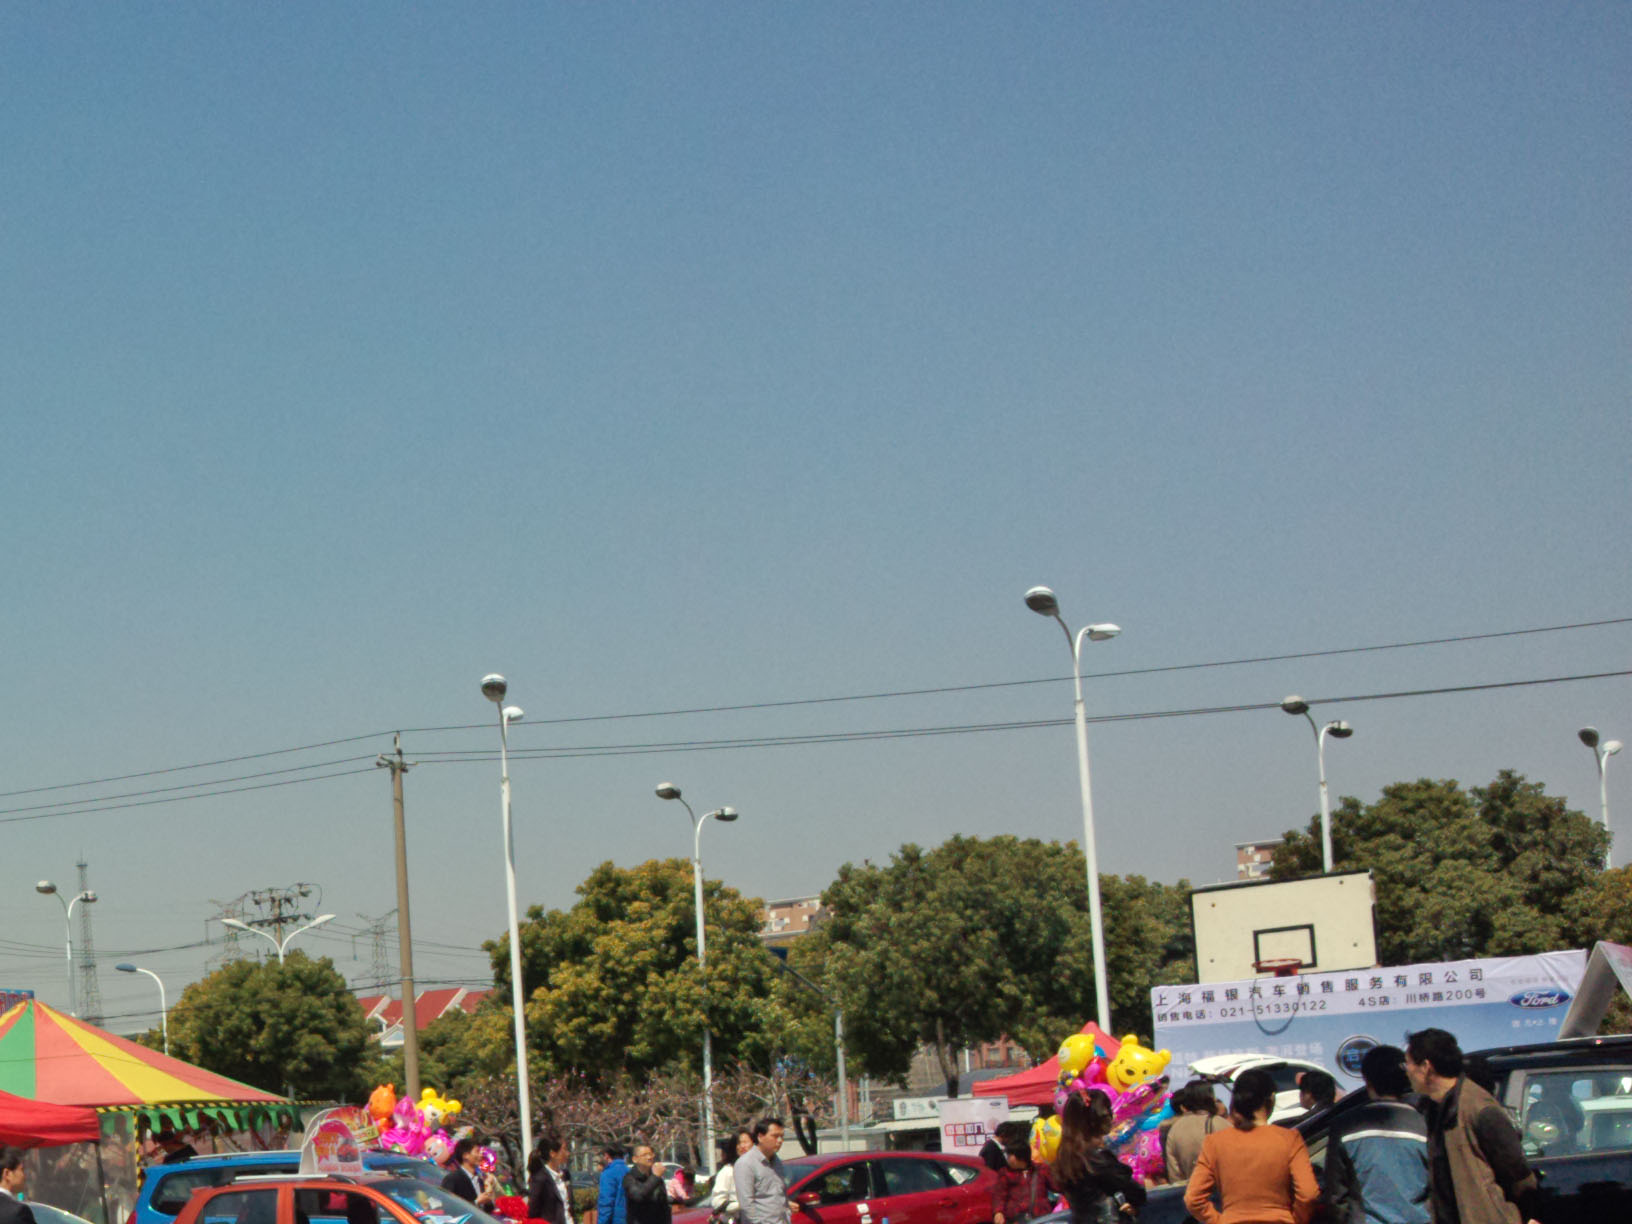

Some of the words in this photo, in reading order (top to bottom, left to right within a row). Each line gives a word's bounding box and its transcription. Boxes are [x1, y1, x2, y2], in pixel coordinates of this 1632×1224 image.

[1156, 968, 1484, 1007] 上海福银汽车销售服务有限公司
[1220, 1000, 1327, 1018] 021-51330122
